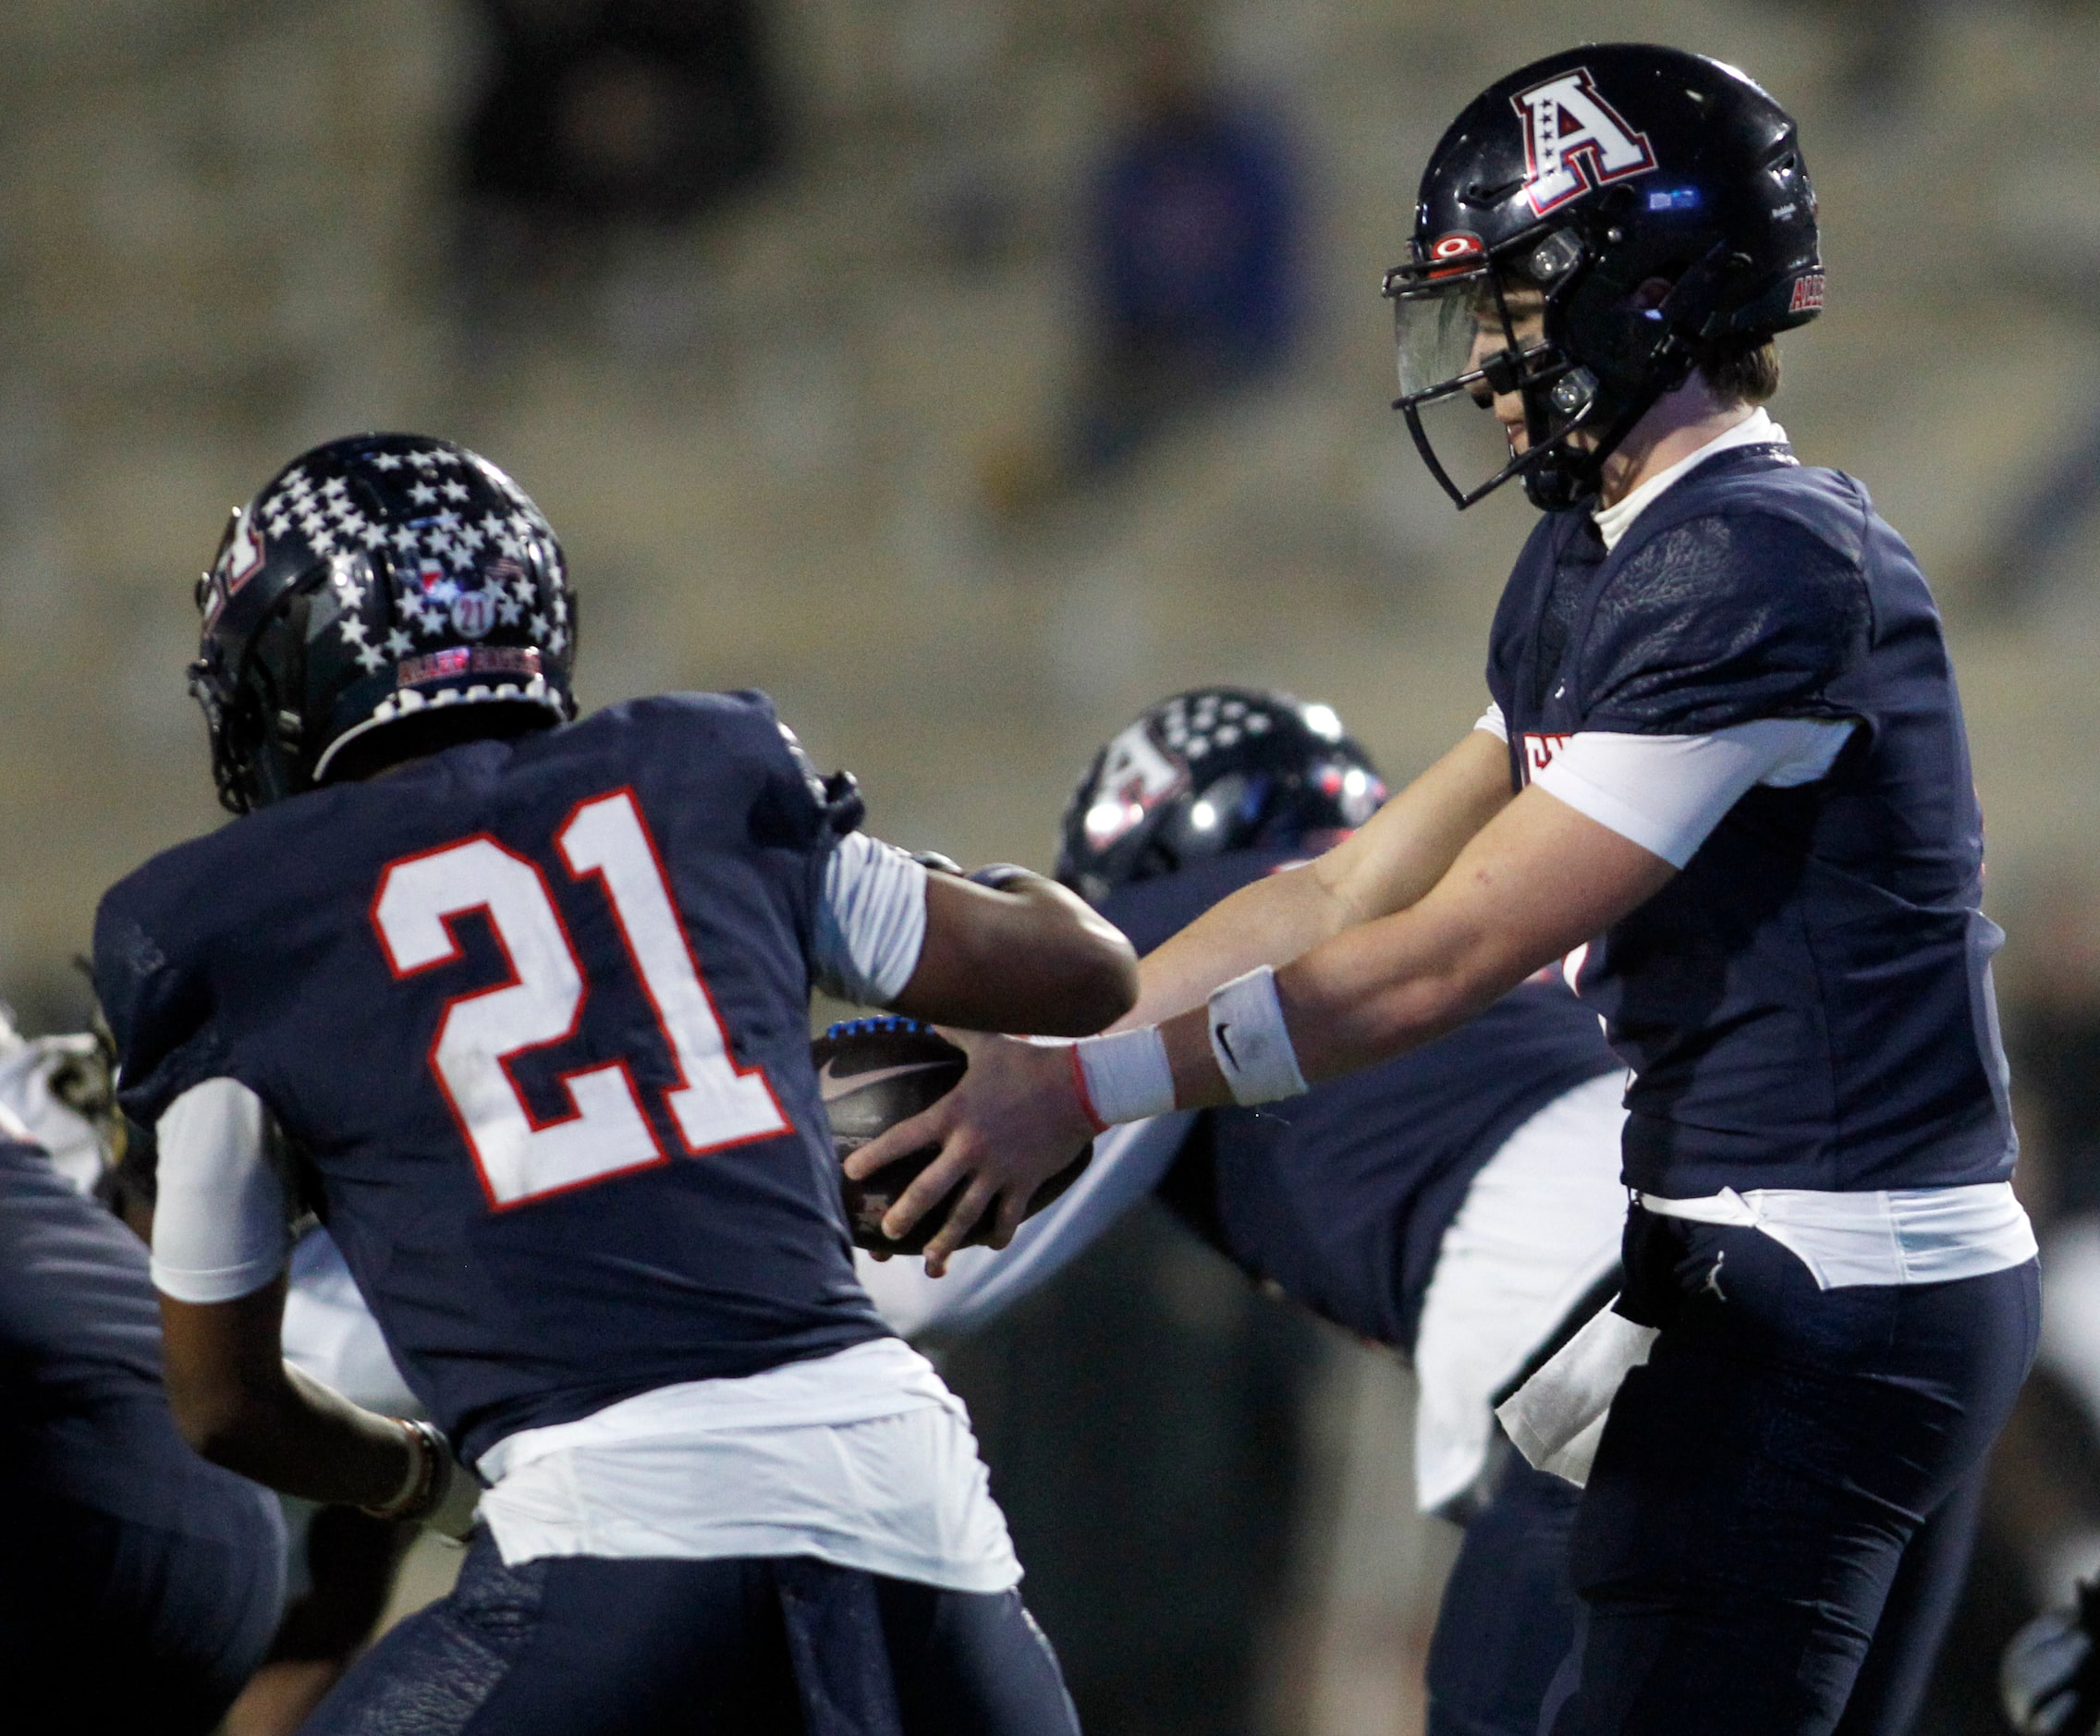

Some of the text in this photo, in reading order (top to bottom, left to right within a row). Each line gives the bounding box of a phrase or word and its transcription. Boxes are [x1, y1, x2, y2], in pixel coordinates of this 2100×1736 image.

[1509, 67, 1659, 219] A
[461, 598, 484, 630] 21
[370, 785, 795, 1213] 21
